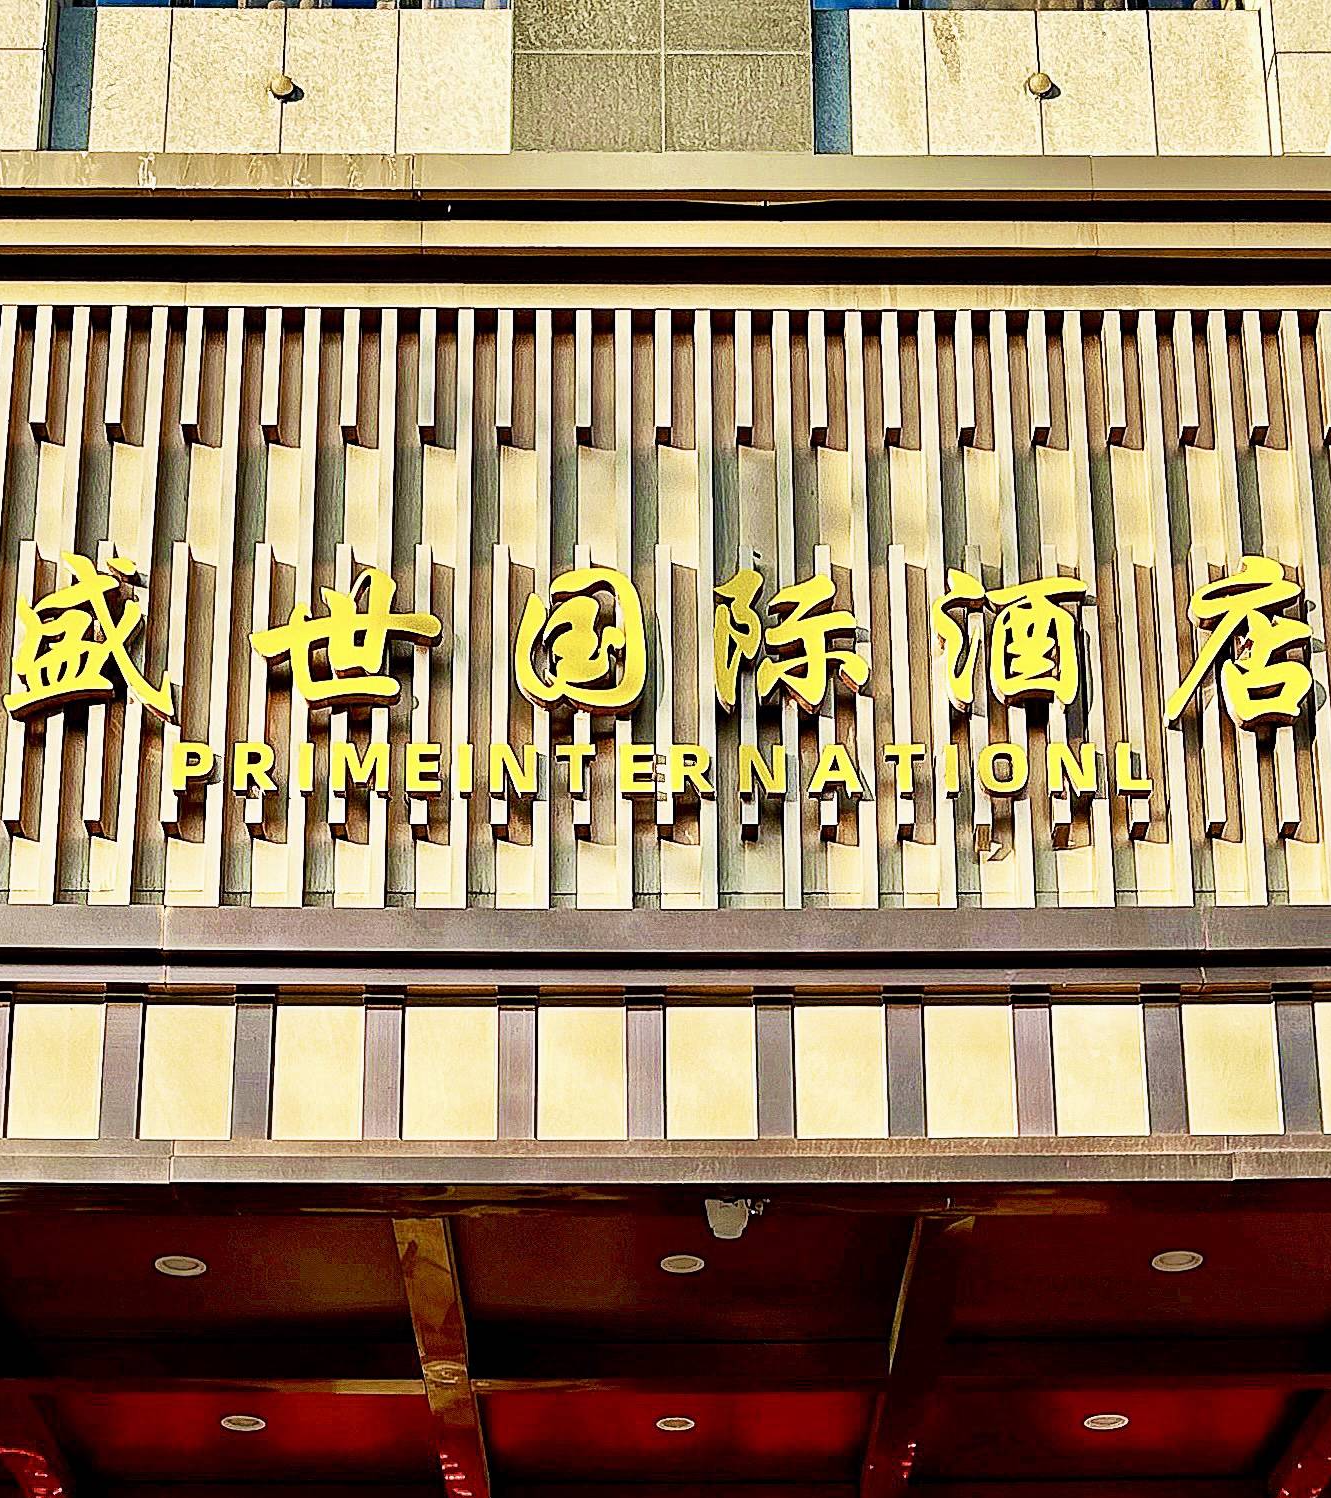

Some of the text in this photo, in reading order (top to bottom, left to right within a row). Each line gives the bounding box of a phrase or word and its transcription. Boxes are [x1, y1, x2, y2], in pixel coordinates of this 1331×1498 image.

[3, 553, 1322, 729] 盛世国际酒店
[171, 740, 1154, 799] PRIMEINTERNATIONL
